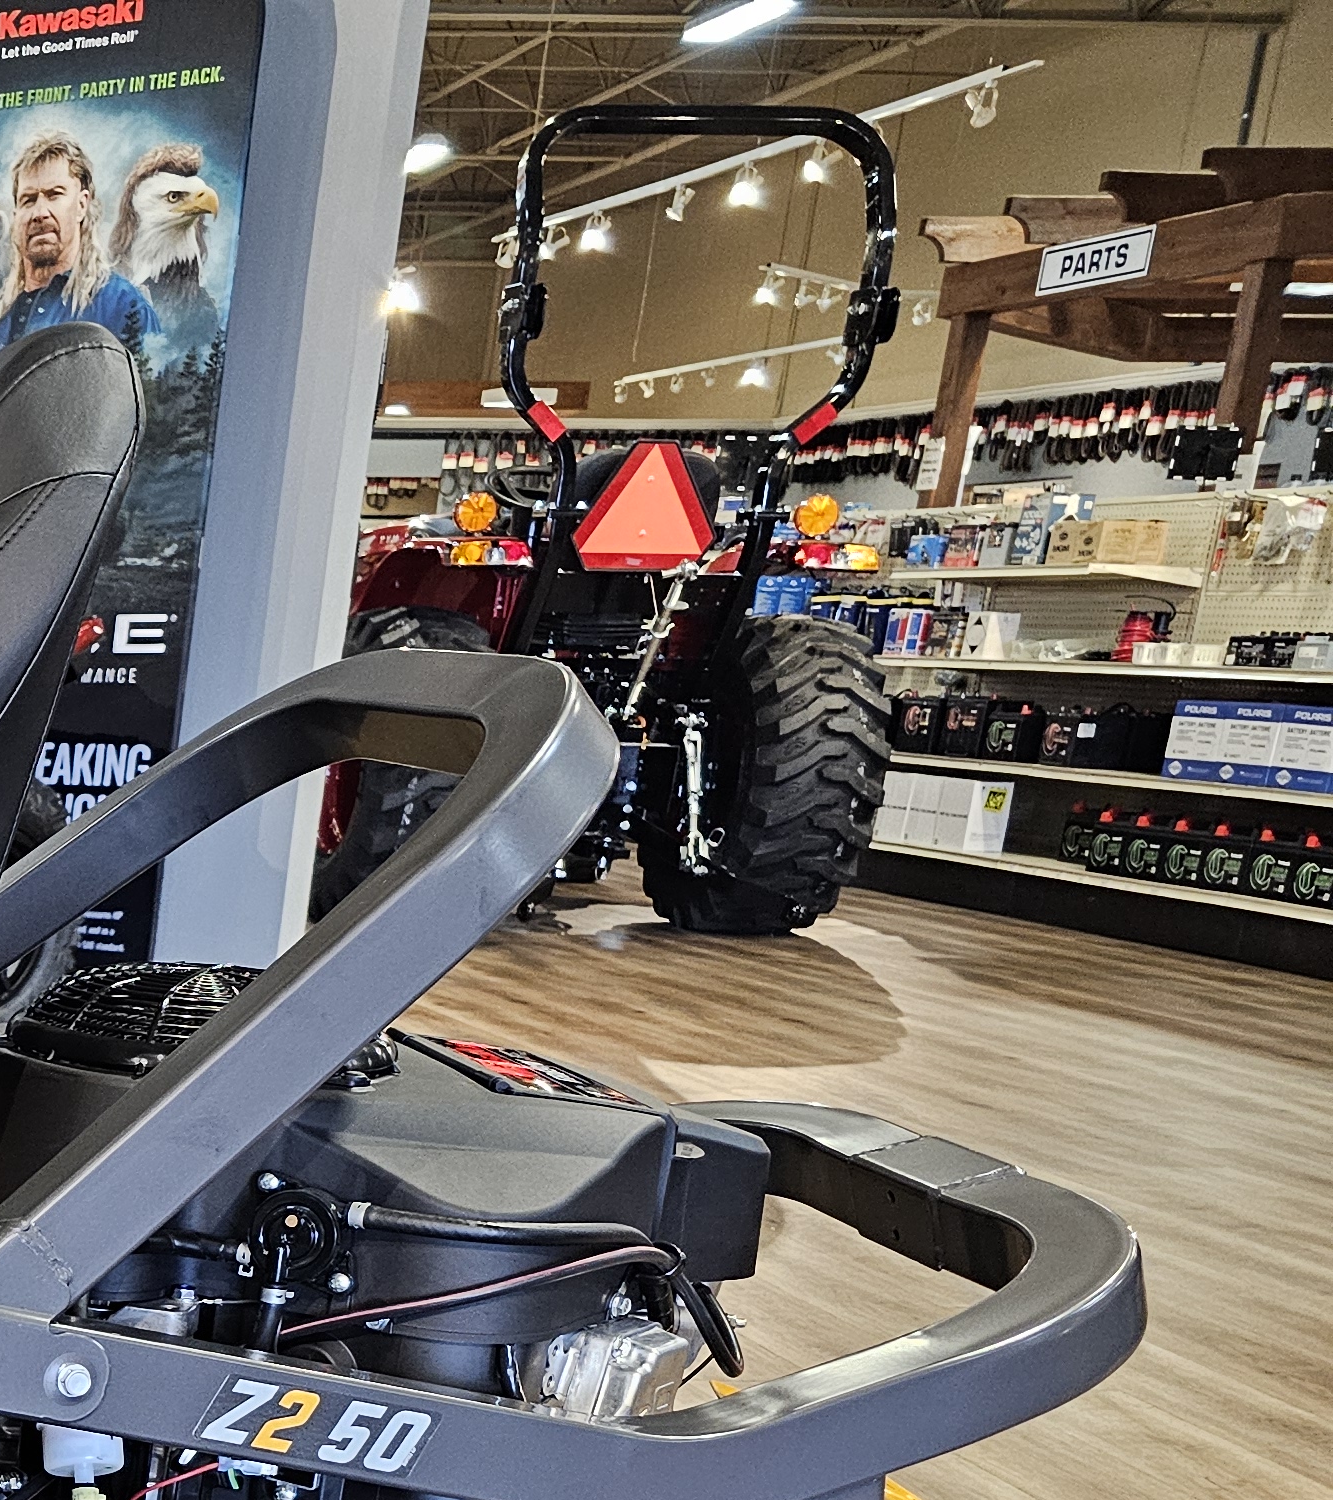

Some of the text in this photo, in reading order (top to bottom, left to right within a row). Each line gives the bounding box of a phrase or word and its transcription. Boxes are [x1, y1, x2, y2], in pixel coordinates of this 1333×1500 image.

[1, 46, 20, 59] Let
[21, 43, 40, 57] the
[42, 38, 73, 55] Good
[74, 34, 109, 50] Times
[26, 85, 76, 106] FRONT.
[80, 78, 126, 99] PARTY
[129, 74, 145, 93] IN
[149, 71, 177, 91] THE
[180, 66, 226, 87] BACK.
[1060, 243, 1129, 279] PARTS
